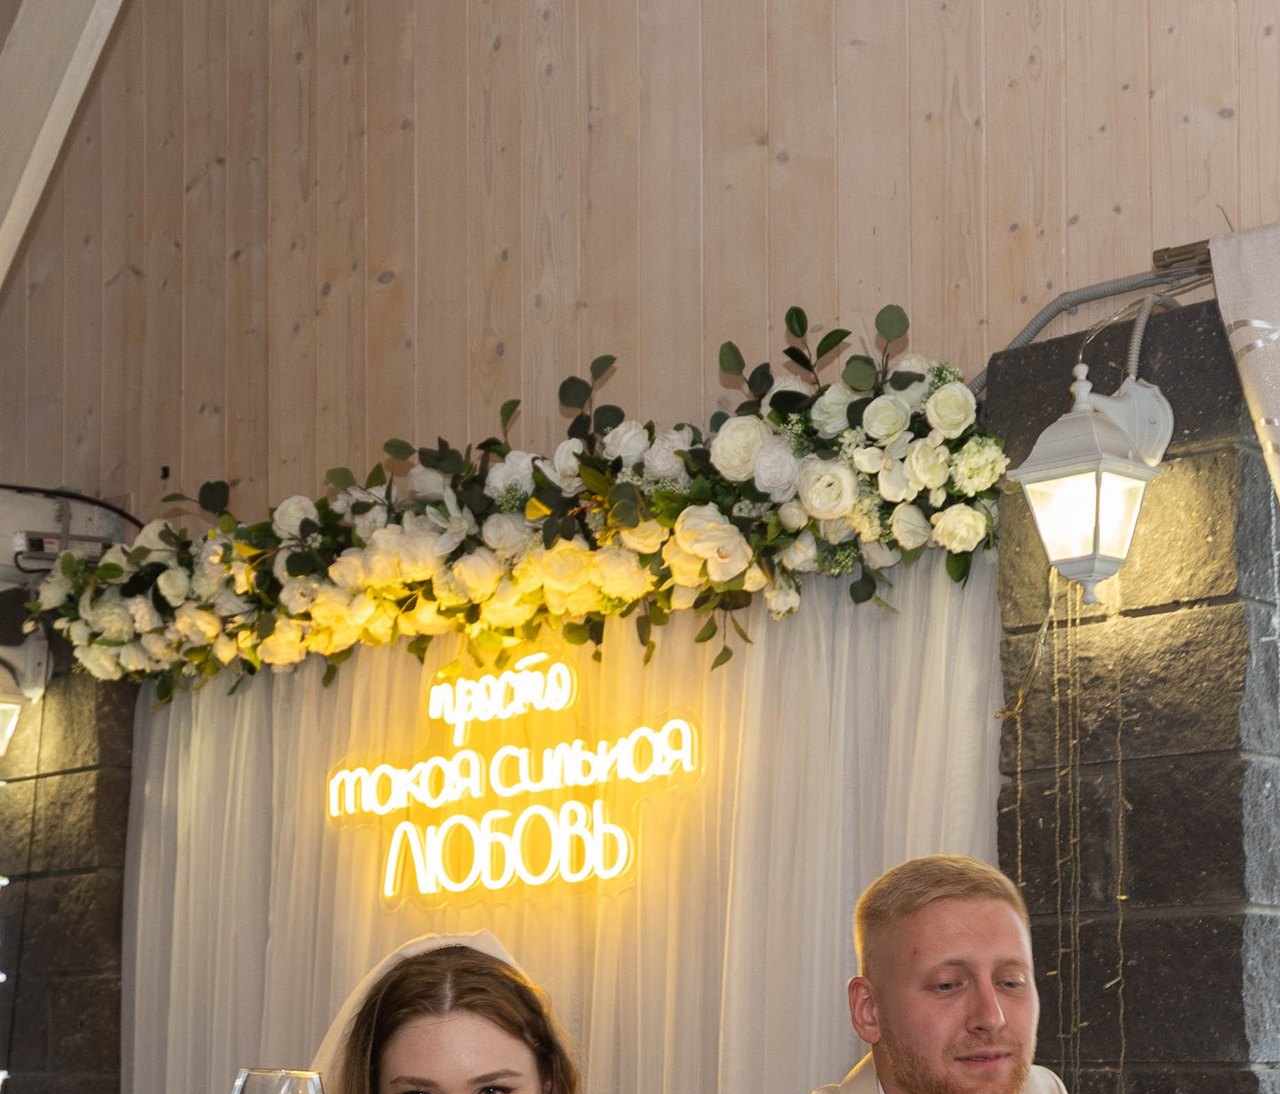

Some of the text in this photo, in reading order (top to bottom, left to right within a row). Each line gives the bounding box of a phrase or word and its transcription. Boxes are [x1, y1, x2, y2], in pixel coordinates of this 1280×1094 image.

[429, 652, 575, 747] просто
[329, 718, 697, 817] такая сильная
